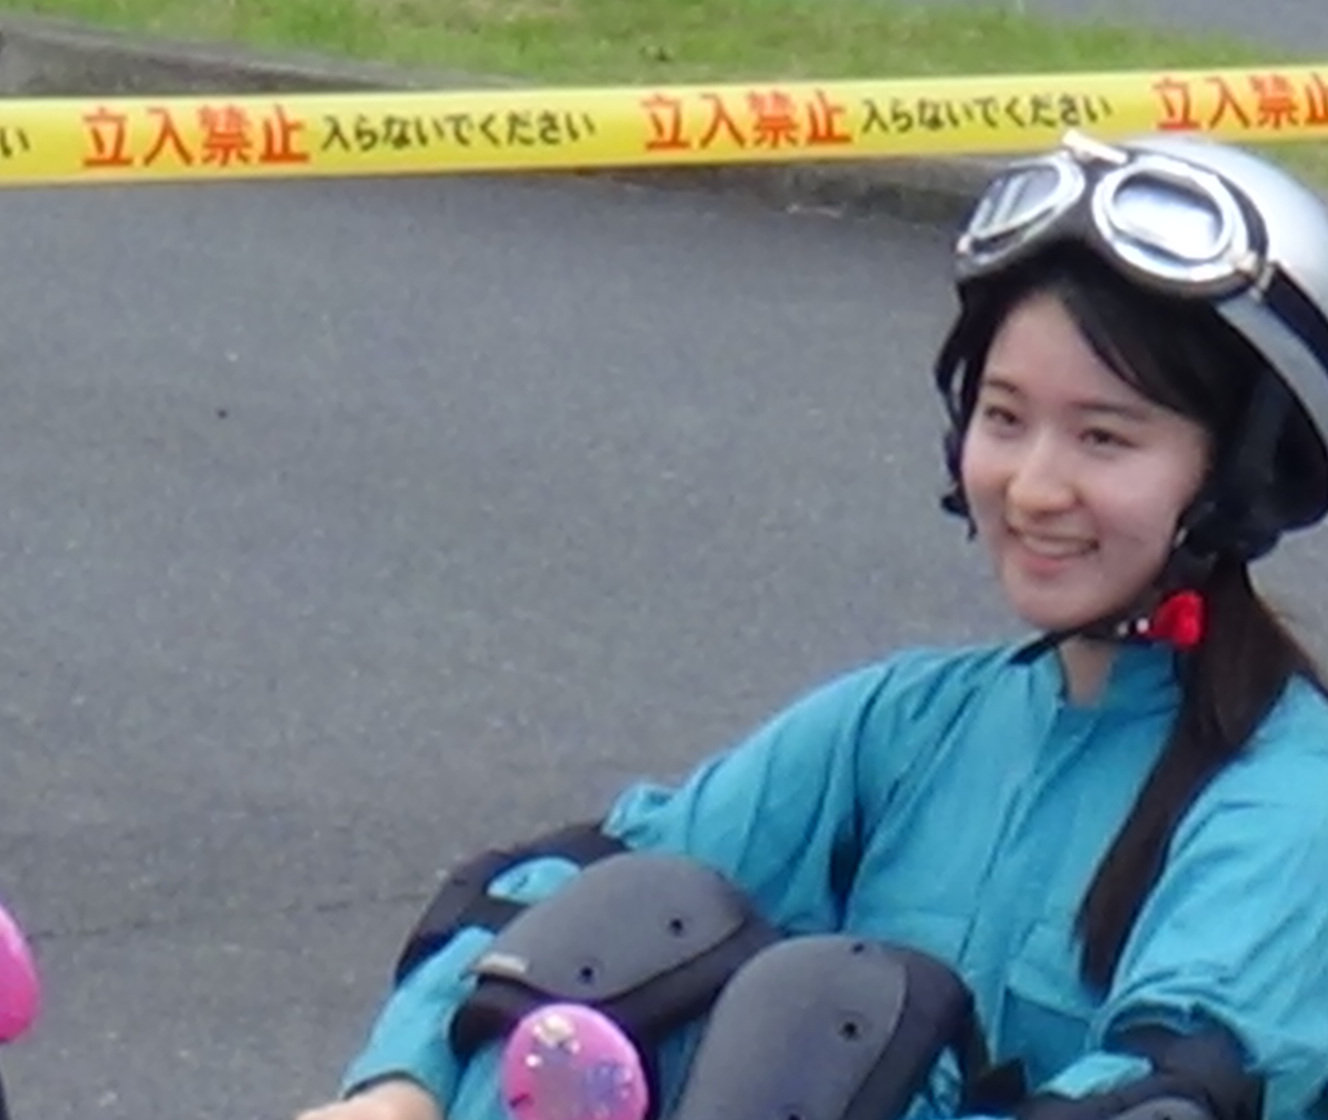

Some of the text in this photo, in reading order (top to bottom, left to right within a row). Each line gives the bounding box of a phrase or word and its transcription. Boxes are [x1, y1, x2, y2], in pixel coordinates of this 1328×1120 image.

[81, 104, 595, 170] 立入禁止 入らないでください
[641, 88, 1112, 153] 立入禁止 入らないでください
